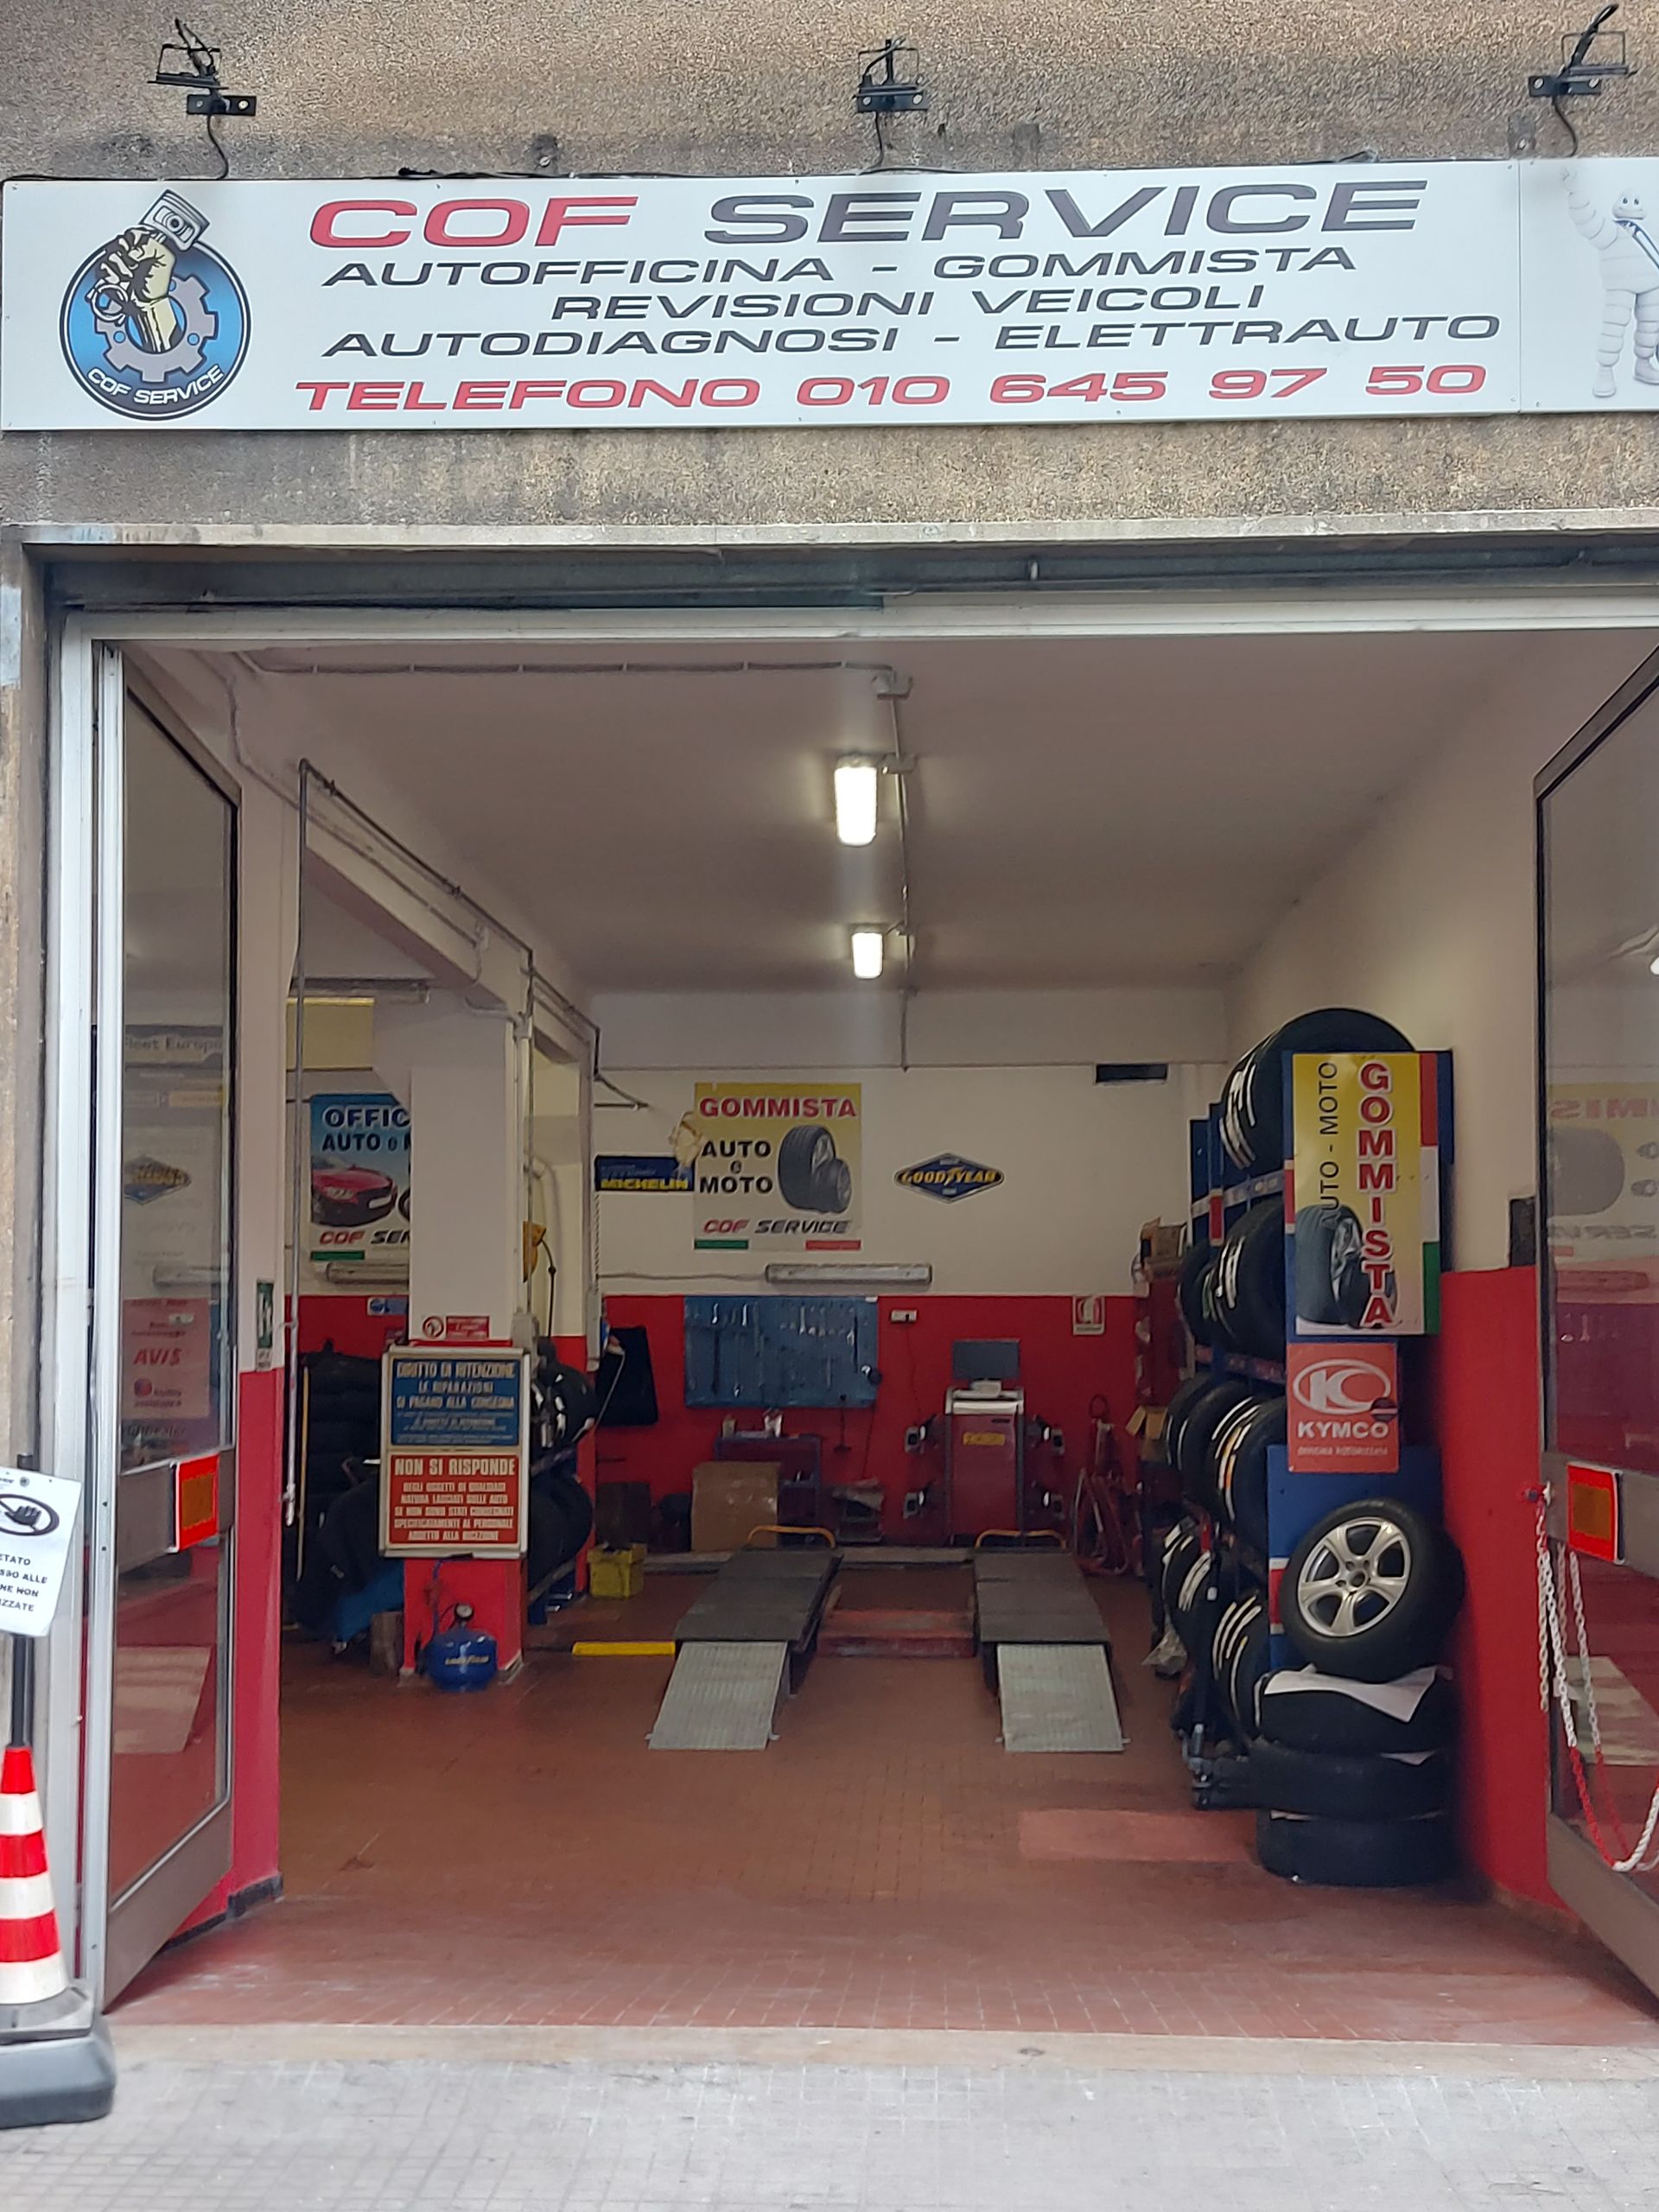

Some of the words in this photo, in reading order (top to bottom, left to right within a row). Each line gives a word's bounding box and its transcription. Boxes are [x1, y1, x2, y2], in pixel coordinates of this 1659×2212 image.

[310, 197, 639, 249] COF
[704, 181, 1427, 245] SERVICE
[321, 258, 834, 287] AUTOFFICINA
[934, 247, 1355, 279] GOMMISTA
[551, 292, 935, 321] REVISIONI
[972, 284, 1264, 315] VEICOLI
[321, 327, 899, 358] AUTODIAGNOSI
[995, 316, 1500, 350] ELETTRAUTO
[86, 367, 132, 397] COF
[133, 365, 225, 405] SERVICE
[296, 378, 760, 410] TELEFONO
[798, 376, 950, 406] 010
[990, 371, 1168, 404] 645
[1210, 368, 1327, 399] 97
[1366, 365, 1486, 395] 50
[699, 1097, 856, 1117] GOMMISTA
[1319, 1062, 1338, 1135] MOTO
[321, 1133, 381, 1152] AUTO
[701, 1140, 772, 1158] AUTO
[601, 1178, 689, 1191] MICHELIN
[699, 1176, 773, 1194] MOTO
[1358, 1061, 1394, 1326] GOMMISTA
[703, 1219, 749, 1234] COF
[754, 1219, 852, 1235] SERVICE
[319, 1230, 365, 1245] COF
[133, 1348, 183, 1367] AVIS
[1297, 1421, 1389, 1439] KYMCO
[395, 1459, 423, 1476] NON
[429, 1459, 443, 1476] SI
[448, 1459, 516, 1476] RISPONDE
[22, 1573, 48, 1584] ALLE
